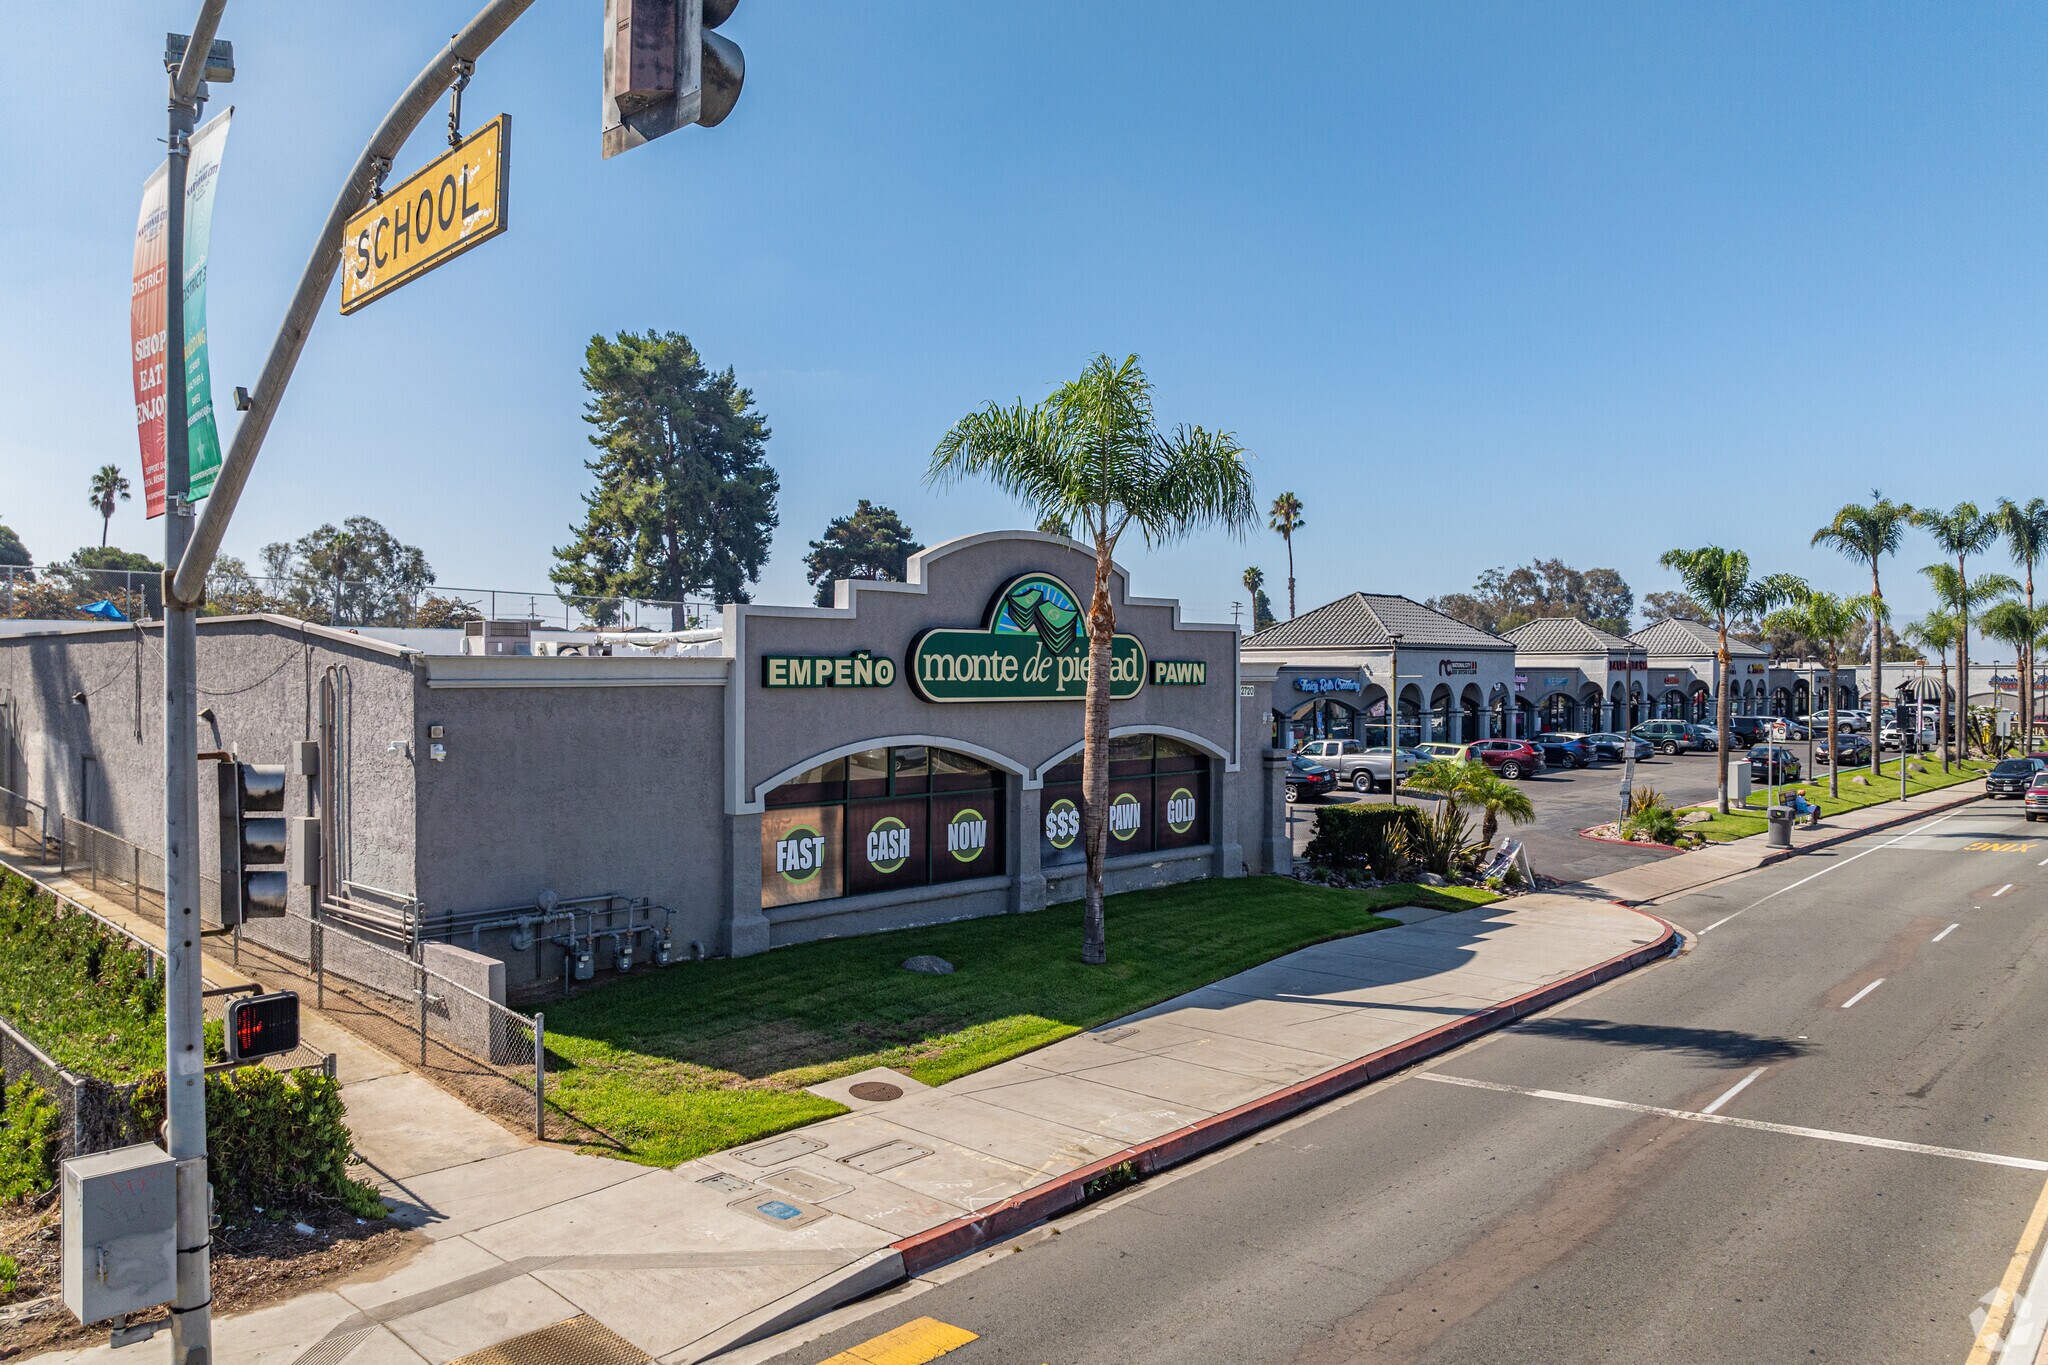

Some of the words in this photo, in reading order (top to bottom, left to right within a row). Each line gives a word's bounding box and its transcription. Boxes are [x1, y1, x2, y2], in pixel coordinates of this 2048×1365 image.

[356, 163, 479, 280] SCHOOL
[133, 267, 165, 297] DISTRICT
[135, 329, 167, 362] SHOP
[139, 363, 164, 392] EAT
[769, 653, 894, 686] EMPEÑO
[922, 650, 1018, 682] monte
[1022, 642, 1052, 682] de
[1056, 647, 1139, 692] piead
[1155, 661, 1205, 684] PAWN
[1240, 686, 1254, 696] 2720
[1045, 806, 1080, 840] $$$
[1109, 803, 1141, 831] PAWN
[1167, 797, 1196, 824] GOLD
[776, 836, 825, 873] FAST
[866, 828, 910, 862] CASH
[947, 820, 987, 851] NOW
